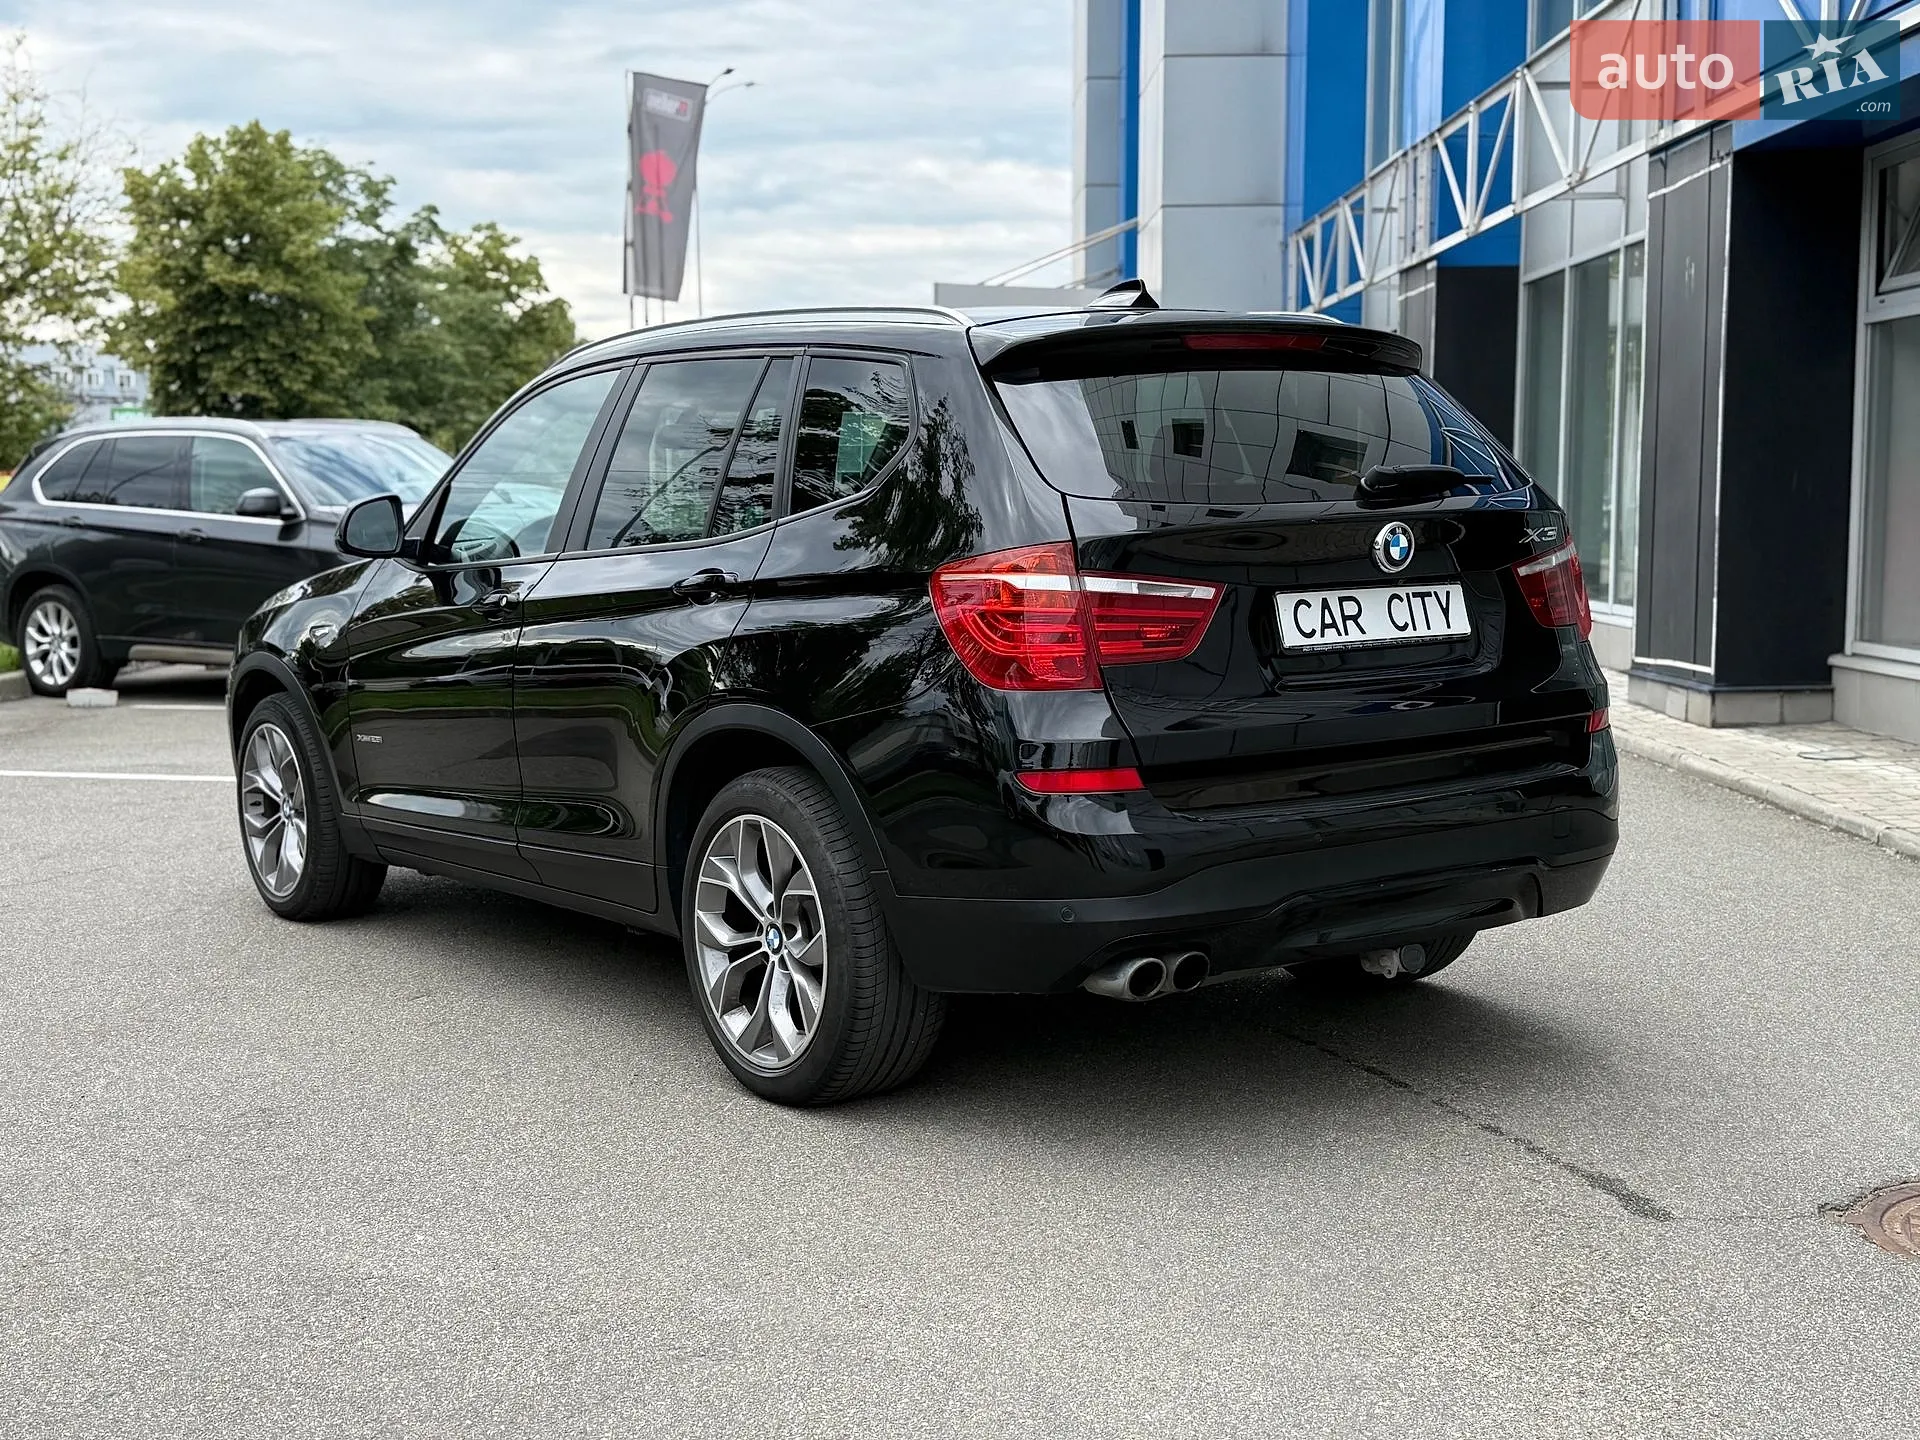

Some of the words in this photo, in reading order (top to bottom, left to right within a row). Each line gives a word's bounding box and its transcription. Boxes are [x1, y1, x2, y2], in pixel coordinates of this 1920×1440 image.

[1518, 526, 1557, 543] X3
[1293, 595, 1366, 638] CAR
[1387, 590, 1451, 632] CITY
